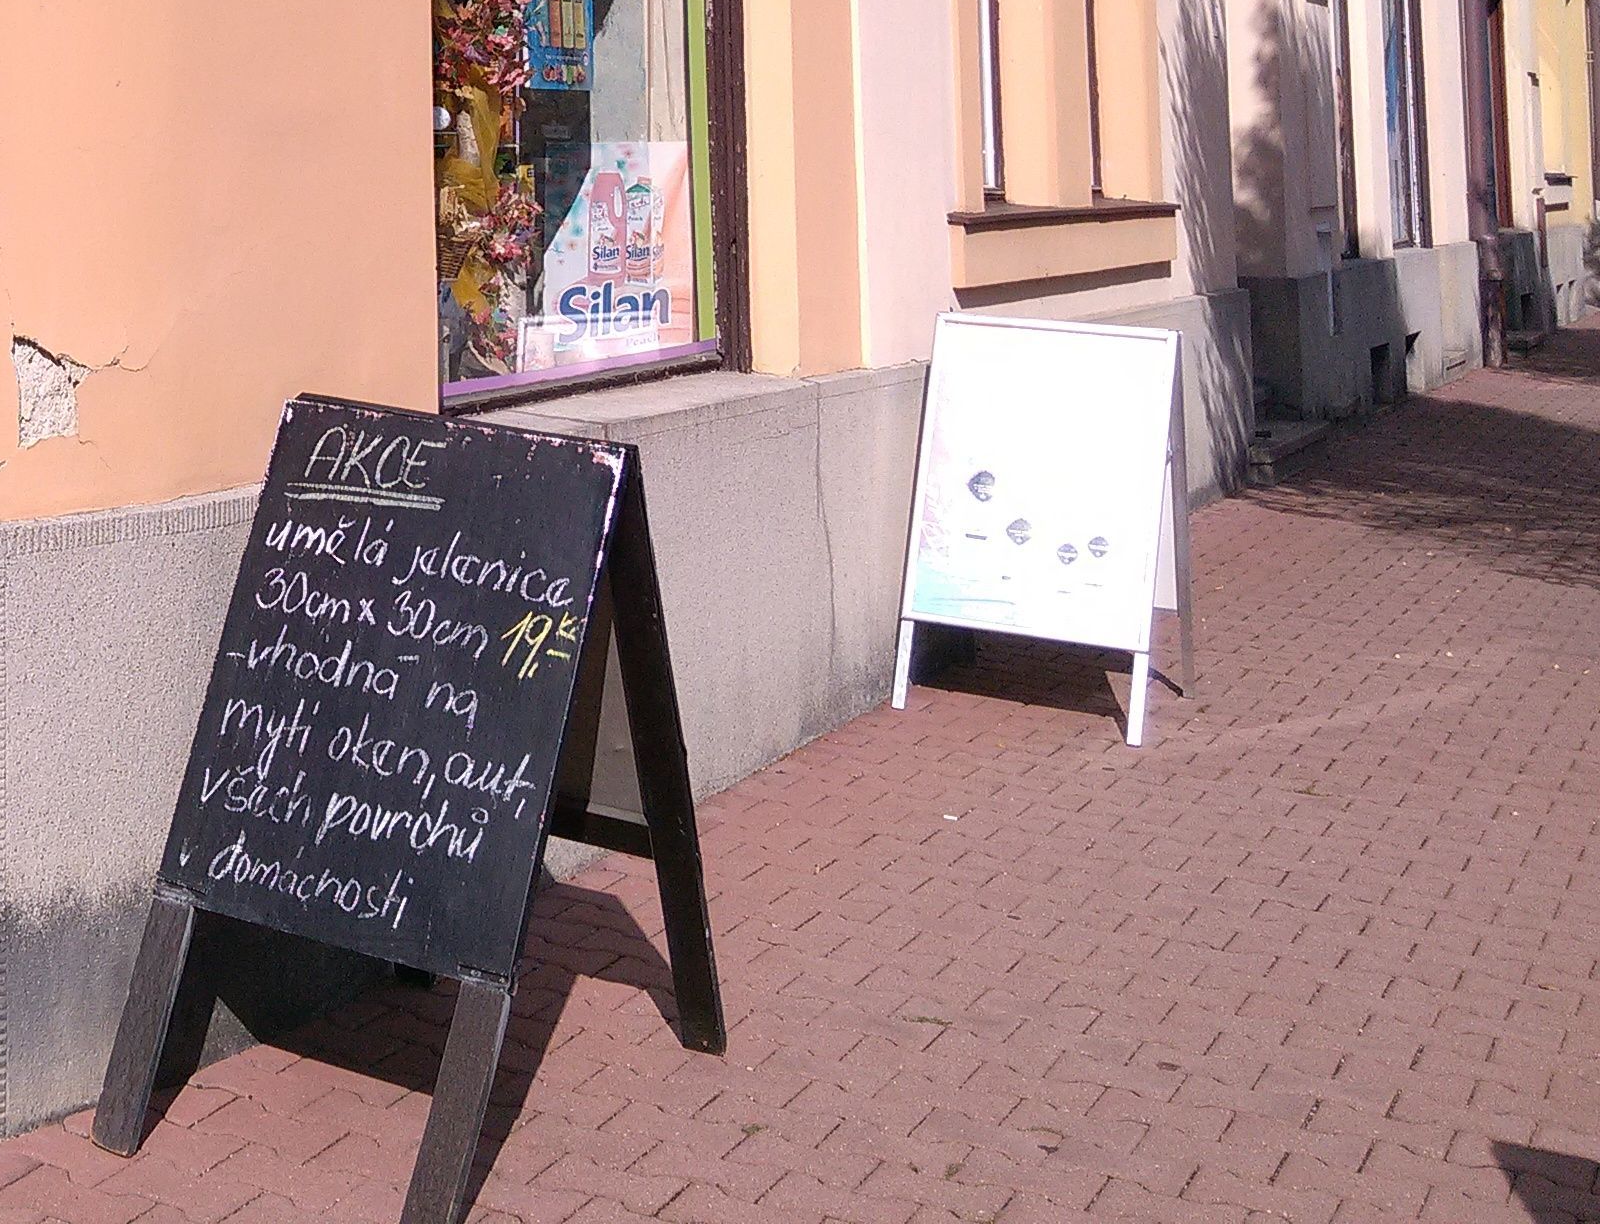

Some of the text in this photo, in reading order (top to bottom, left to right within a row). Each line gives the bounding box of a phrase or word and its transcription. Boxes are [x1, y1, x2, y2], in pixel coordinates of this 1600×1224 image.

[593, 246, 620, 260] Silan
[625, 244, 650, 260] Silan
[558, 282, 670, 344] Silan
[304, 424, 447, 489] AKCE
[265, 515, 575, 607] umělá jelenice
[424, 681, 480, 731] na
[313, 789, 491, 864] povrchů
[208, 830, 415, 929] domácnosti
